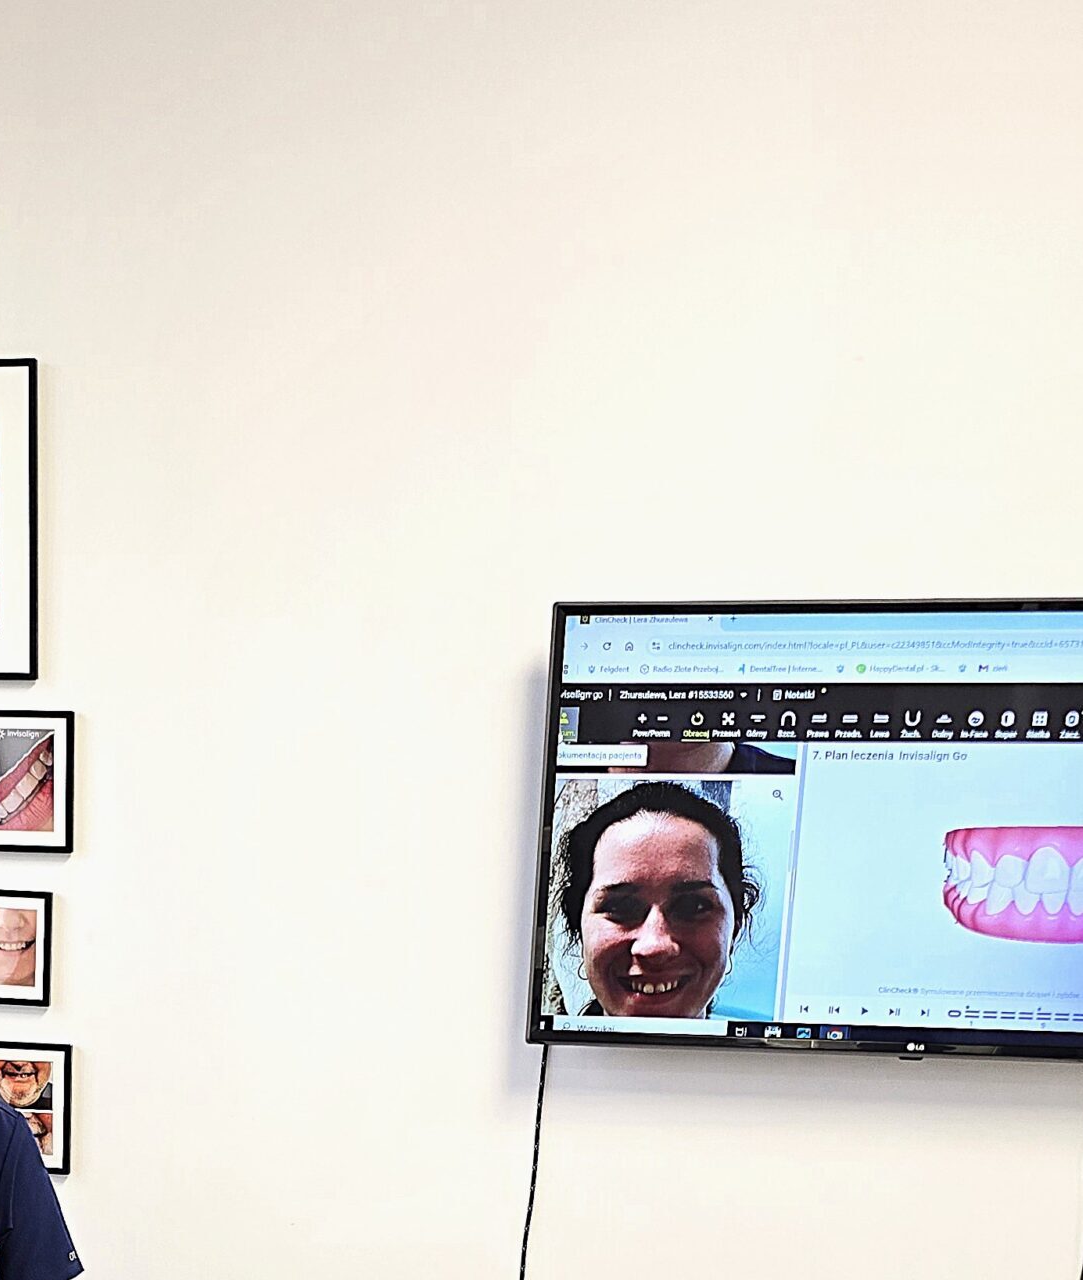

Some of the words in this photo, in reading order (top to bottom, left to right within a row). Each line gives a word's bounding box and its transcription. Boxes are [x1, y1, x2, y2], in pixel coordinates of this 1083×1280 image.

[595, 616, 628, 624] ClinCheck
[608, 752, 643, 760] pacjenta
[812, 750, 822, 760] 7.
[824, 750, 847, 760] Plan
[850, 750, 894, 760] leczenia
[899, 751, 950, 762] Invisalign
[952, 751, 968, 761] Go
